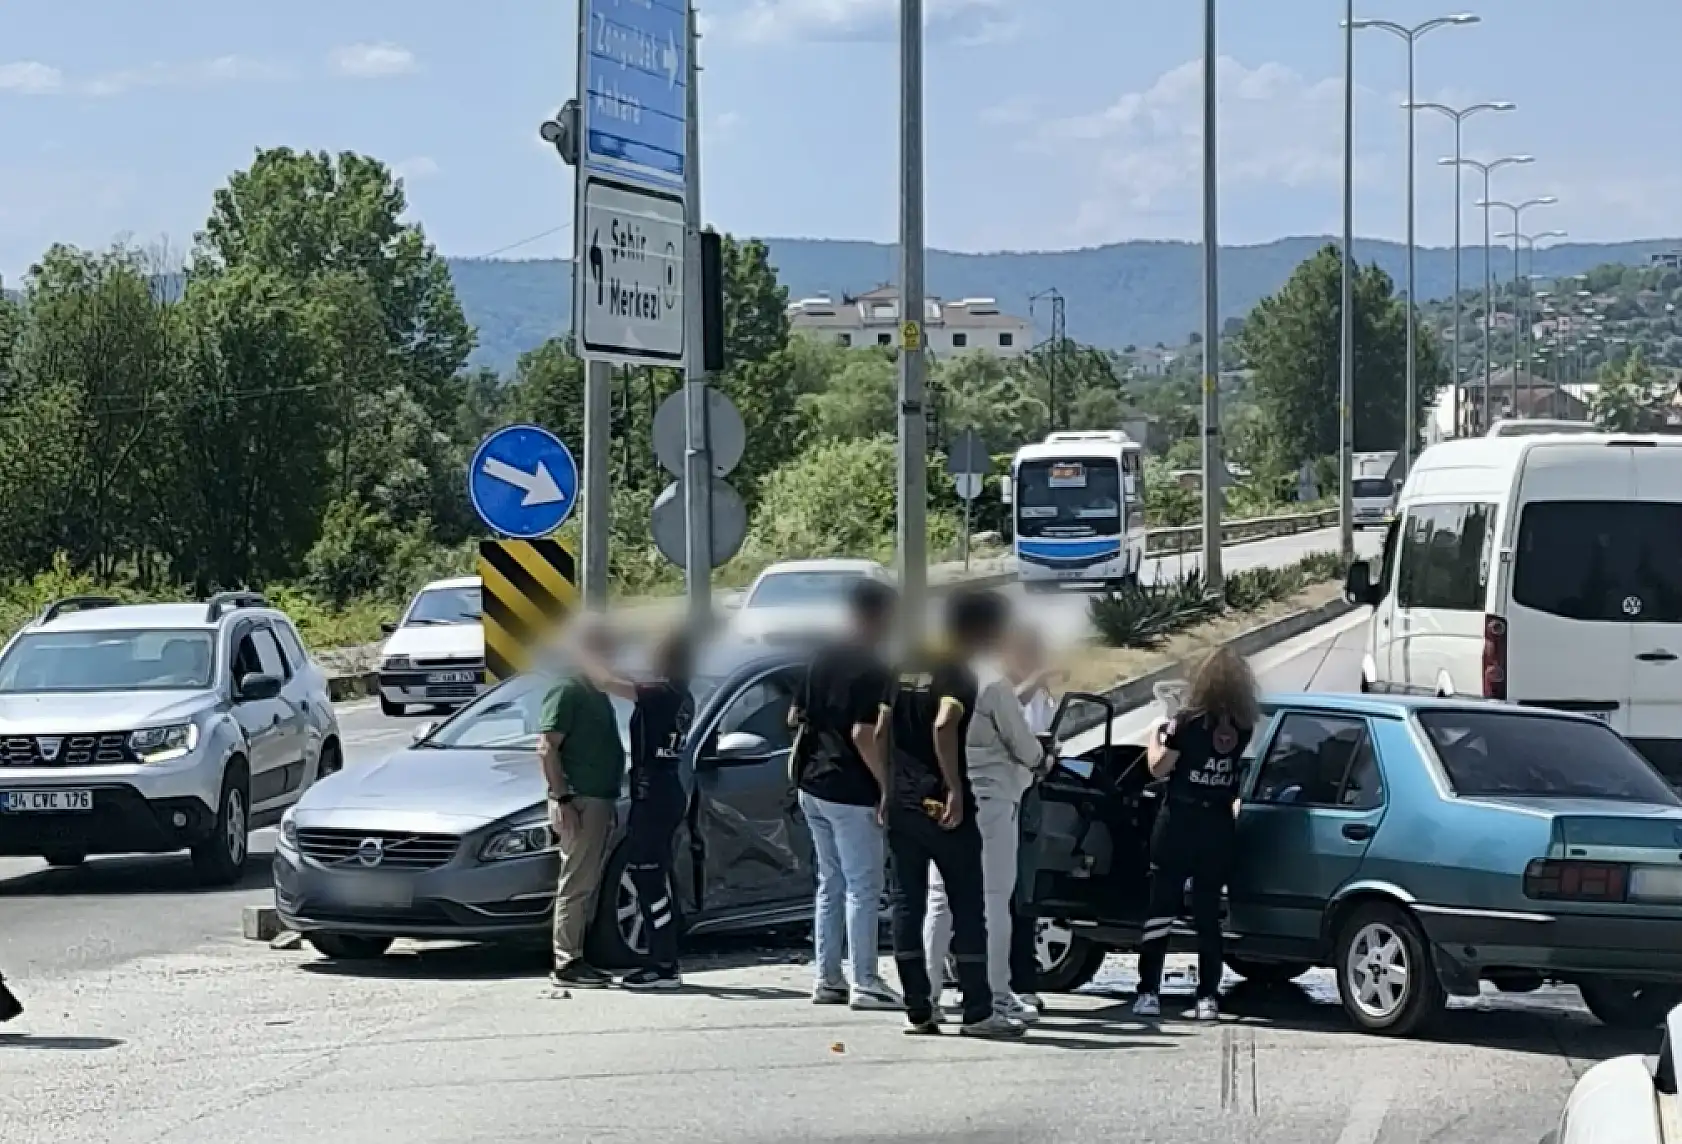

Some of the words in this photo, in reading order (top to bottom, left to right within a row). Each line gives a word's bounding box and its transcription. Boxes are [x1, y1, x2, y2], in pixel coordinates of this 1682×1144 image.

[596, 12, 658, 71] Zonguldak
[596, 74, 641, 126] Ankara
[611, 218, 647, 263] Şehir
[610, 276, 660, 320] Merkezi
[10, 792, 27, 808] 34
[33, 792, 58, 808] CVC
[64, 791, 89, 808] 176
